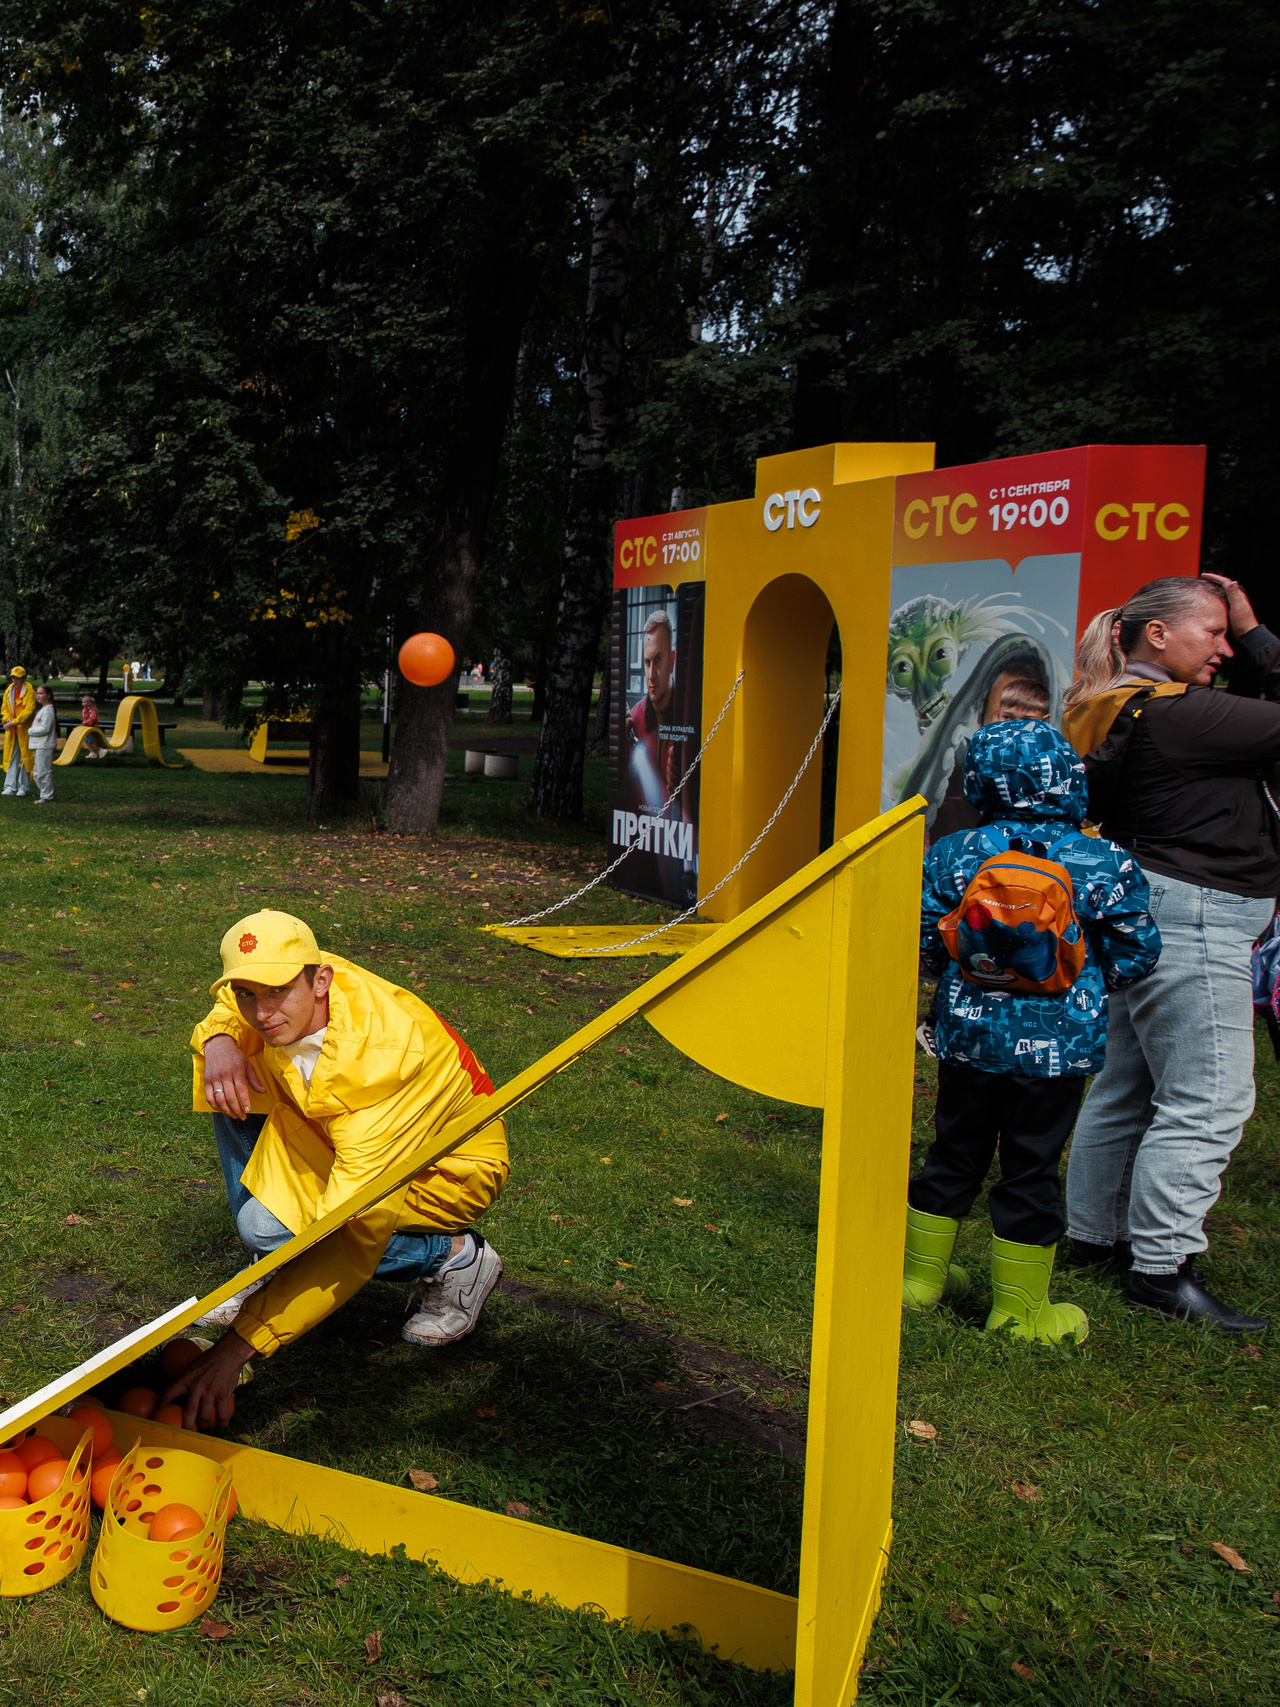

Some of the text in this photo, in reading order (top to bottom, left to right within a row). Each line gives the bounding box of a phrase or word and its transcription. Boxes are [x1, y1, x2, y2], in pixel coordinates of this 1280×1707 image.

[989, 478, 1071, 500] С 1 СЕНТЯБРЯ
[763, 487, 821, 532] СТС
[903, 492, 1070, 540] СТС 19:00
[1095, 502, 1190, 541] СТС
[620, 535, 701, 570] СТС 17:00
[674, 529, 700, 540] АВГУСТА
[612, 809, 694, 862] ПРЯТКИ
